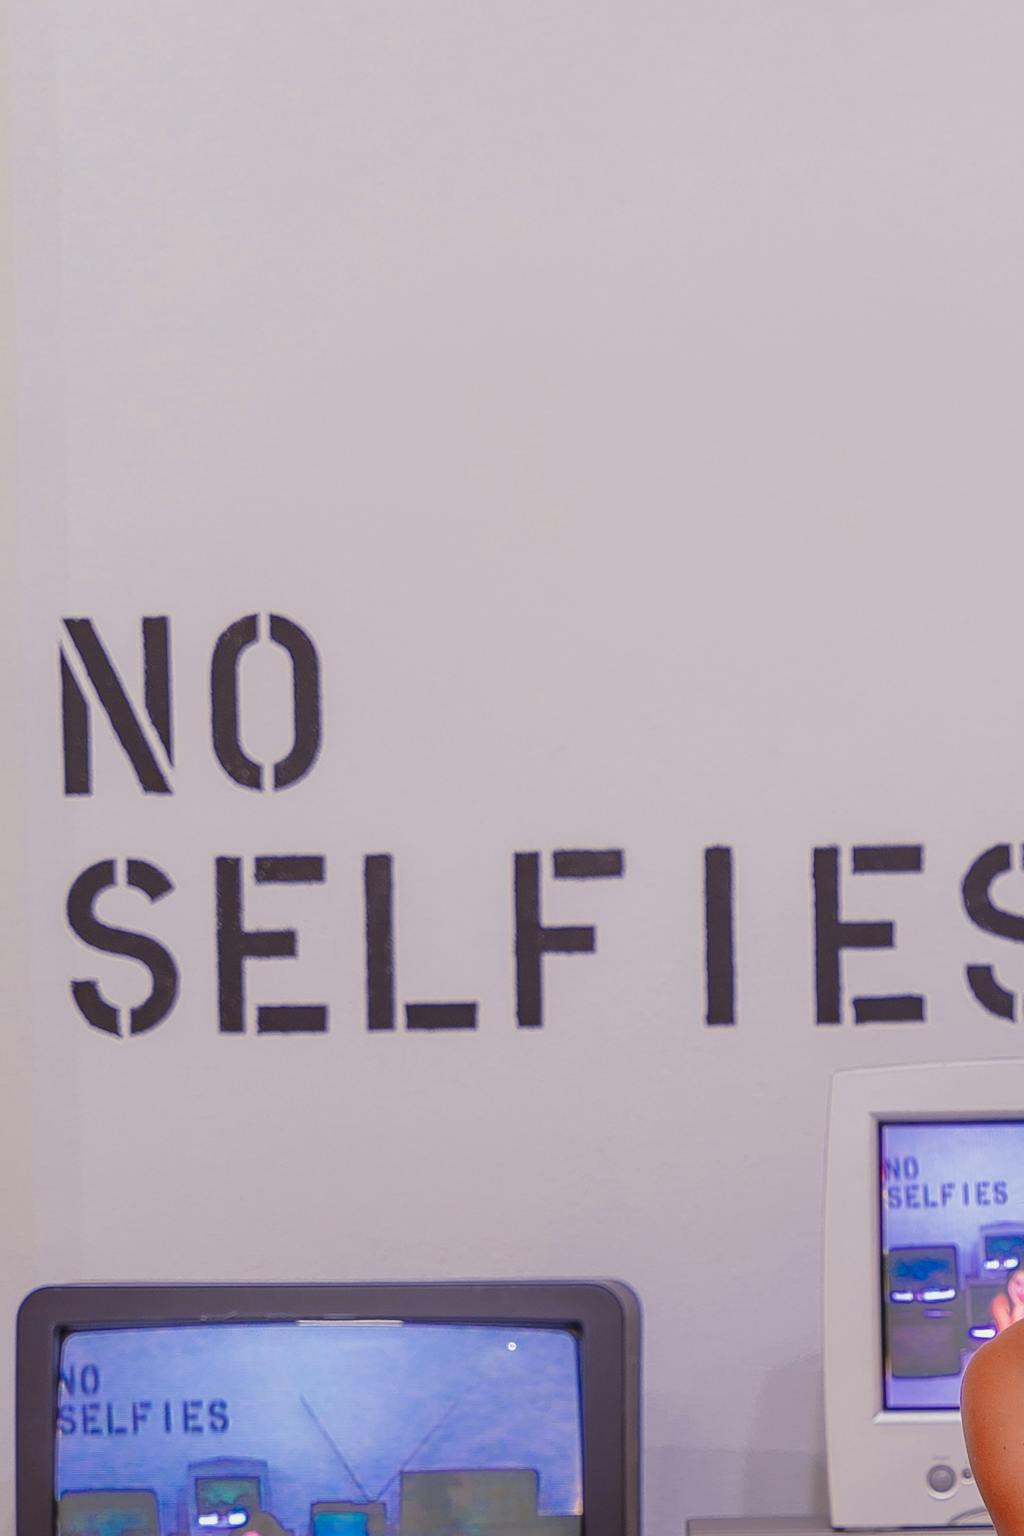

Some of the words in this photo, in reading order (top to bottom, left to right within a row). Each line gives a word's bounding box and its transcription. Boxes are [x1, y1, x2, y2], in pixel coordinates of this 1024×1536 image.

[59, 613, 323, 797] NO
[882, 1155, 919, 1179] NO
[887, 1181, 1009, 1208] SELFIES
[58, 1399, 230, 1436] SELFIES
